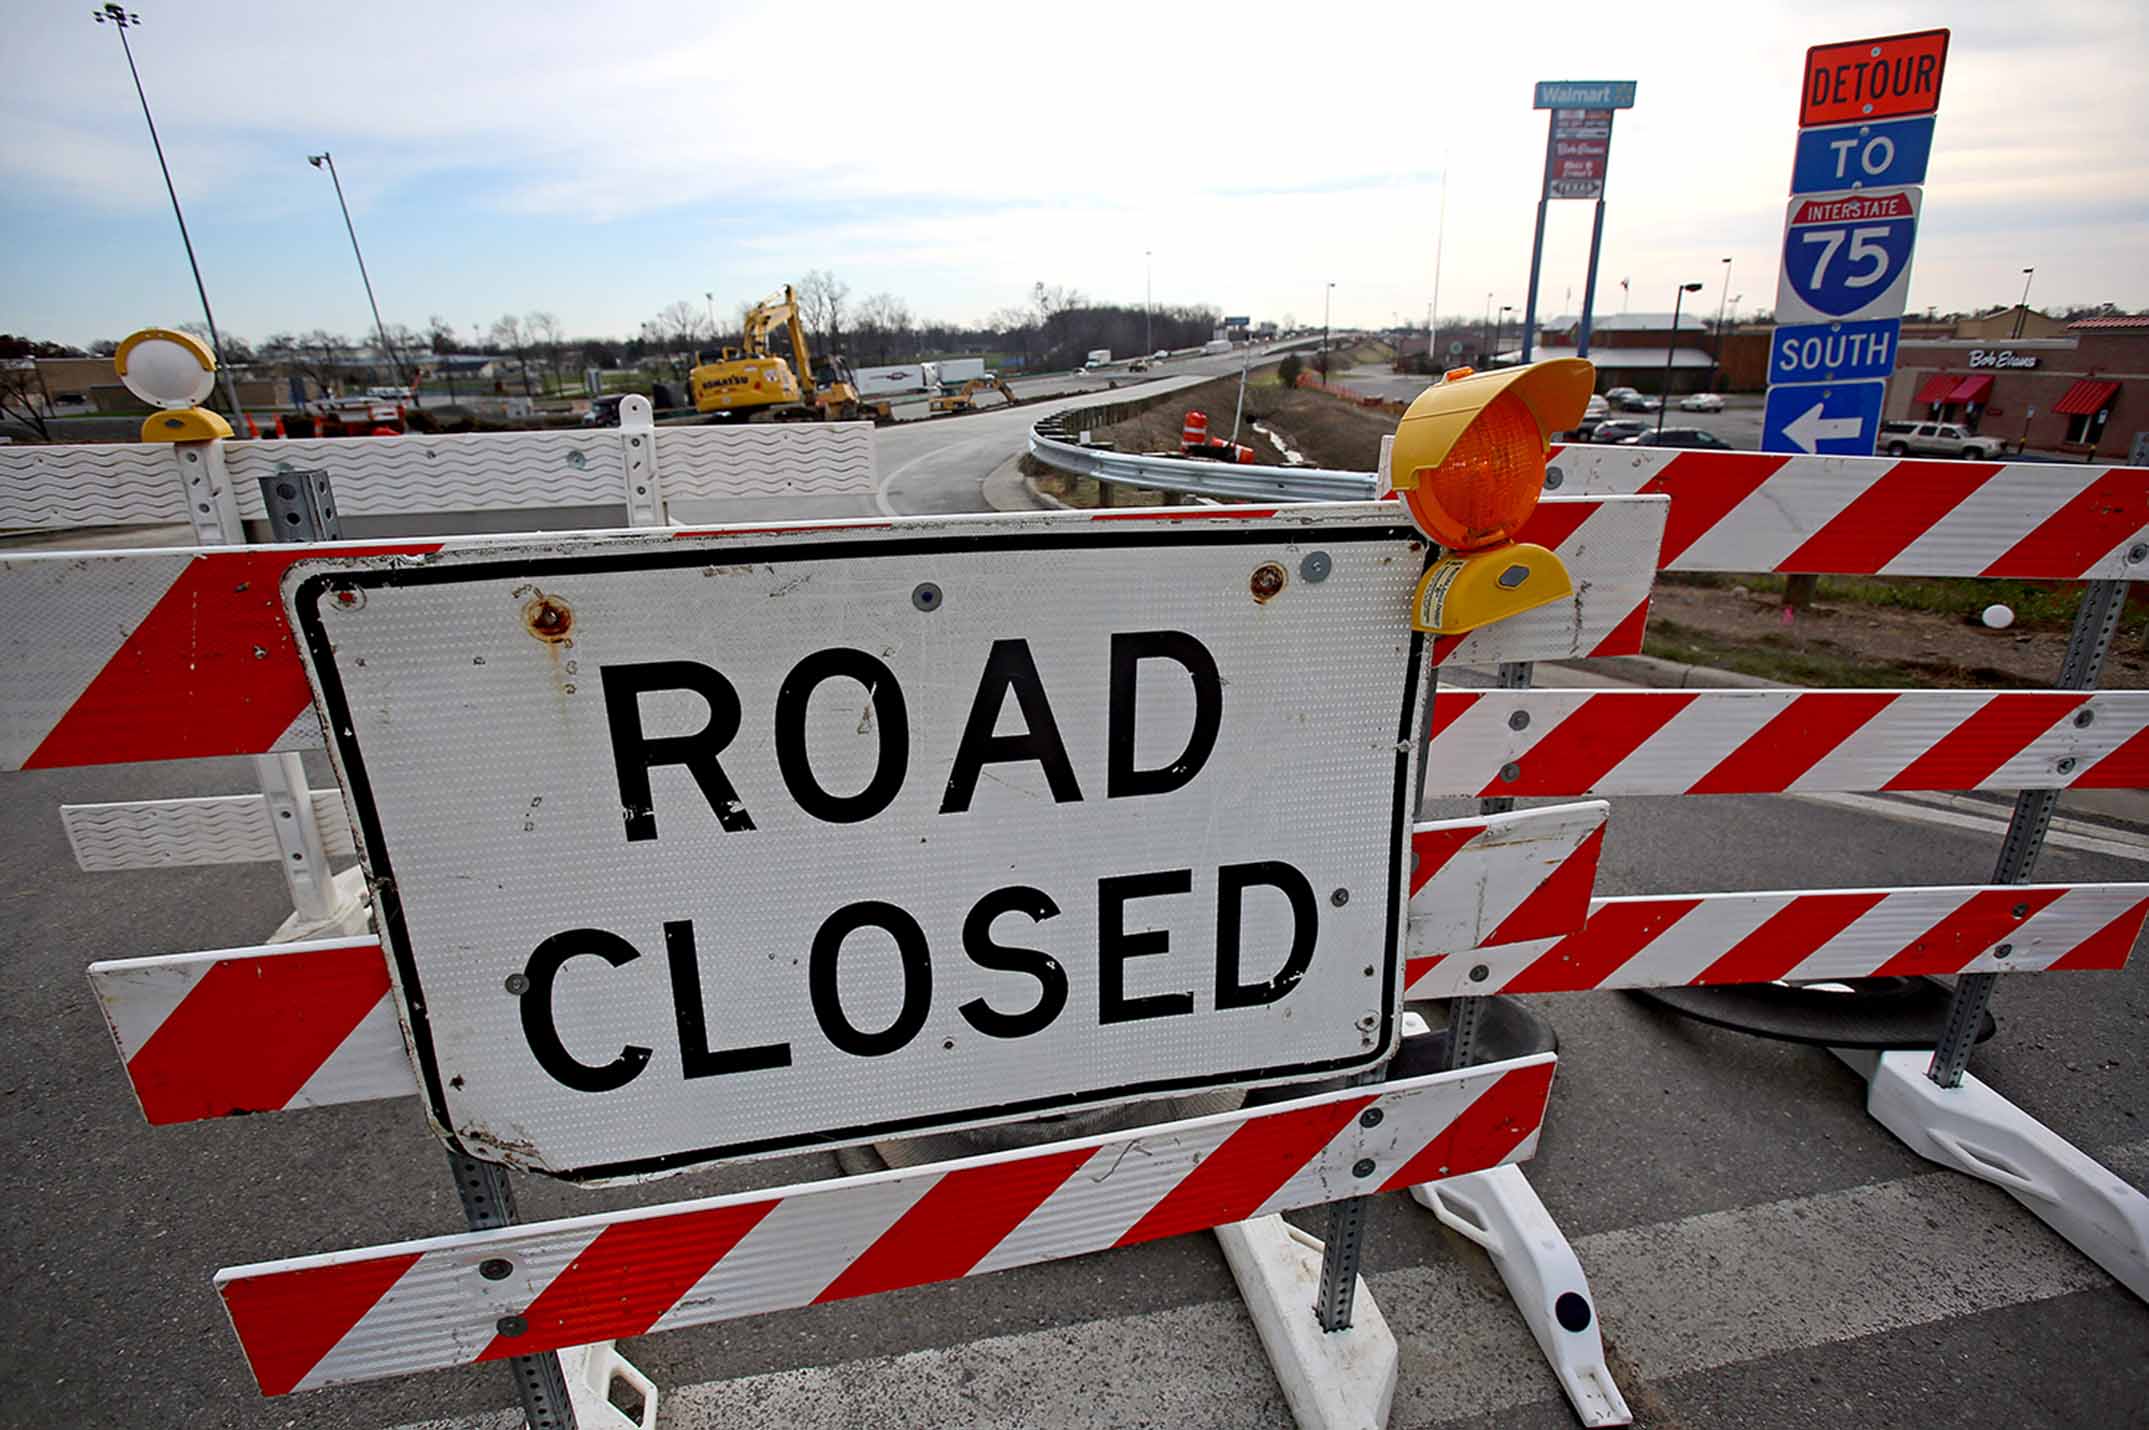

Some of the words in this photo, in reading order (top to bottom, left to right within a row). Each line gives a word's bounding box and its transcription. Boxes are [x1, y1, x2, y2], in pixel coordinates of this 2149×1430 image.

[1542, 86, 1611, 103] Walmart
[1812, 54, 1936, 106] DETOUR
[1830, 136, 1895, 178] TO
[1808, 199, 1899, 220] INTERSTATE
[1802, 226, 1890, 290] 75
[1779, 331, 1890, 371] SOUTH
[1968, 349, 1997, 368] Bob
[600, 630, 1223, 842] ROAD
[519, 861, 1319, 1093] CLOSED
